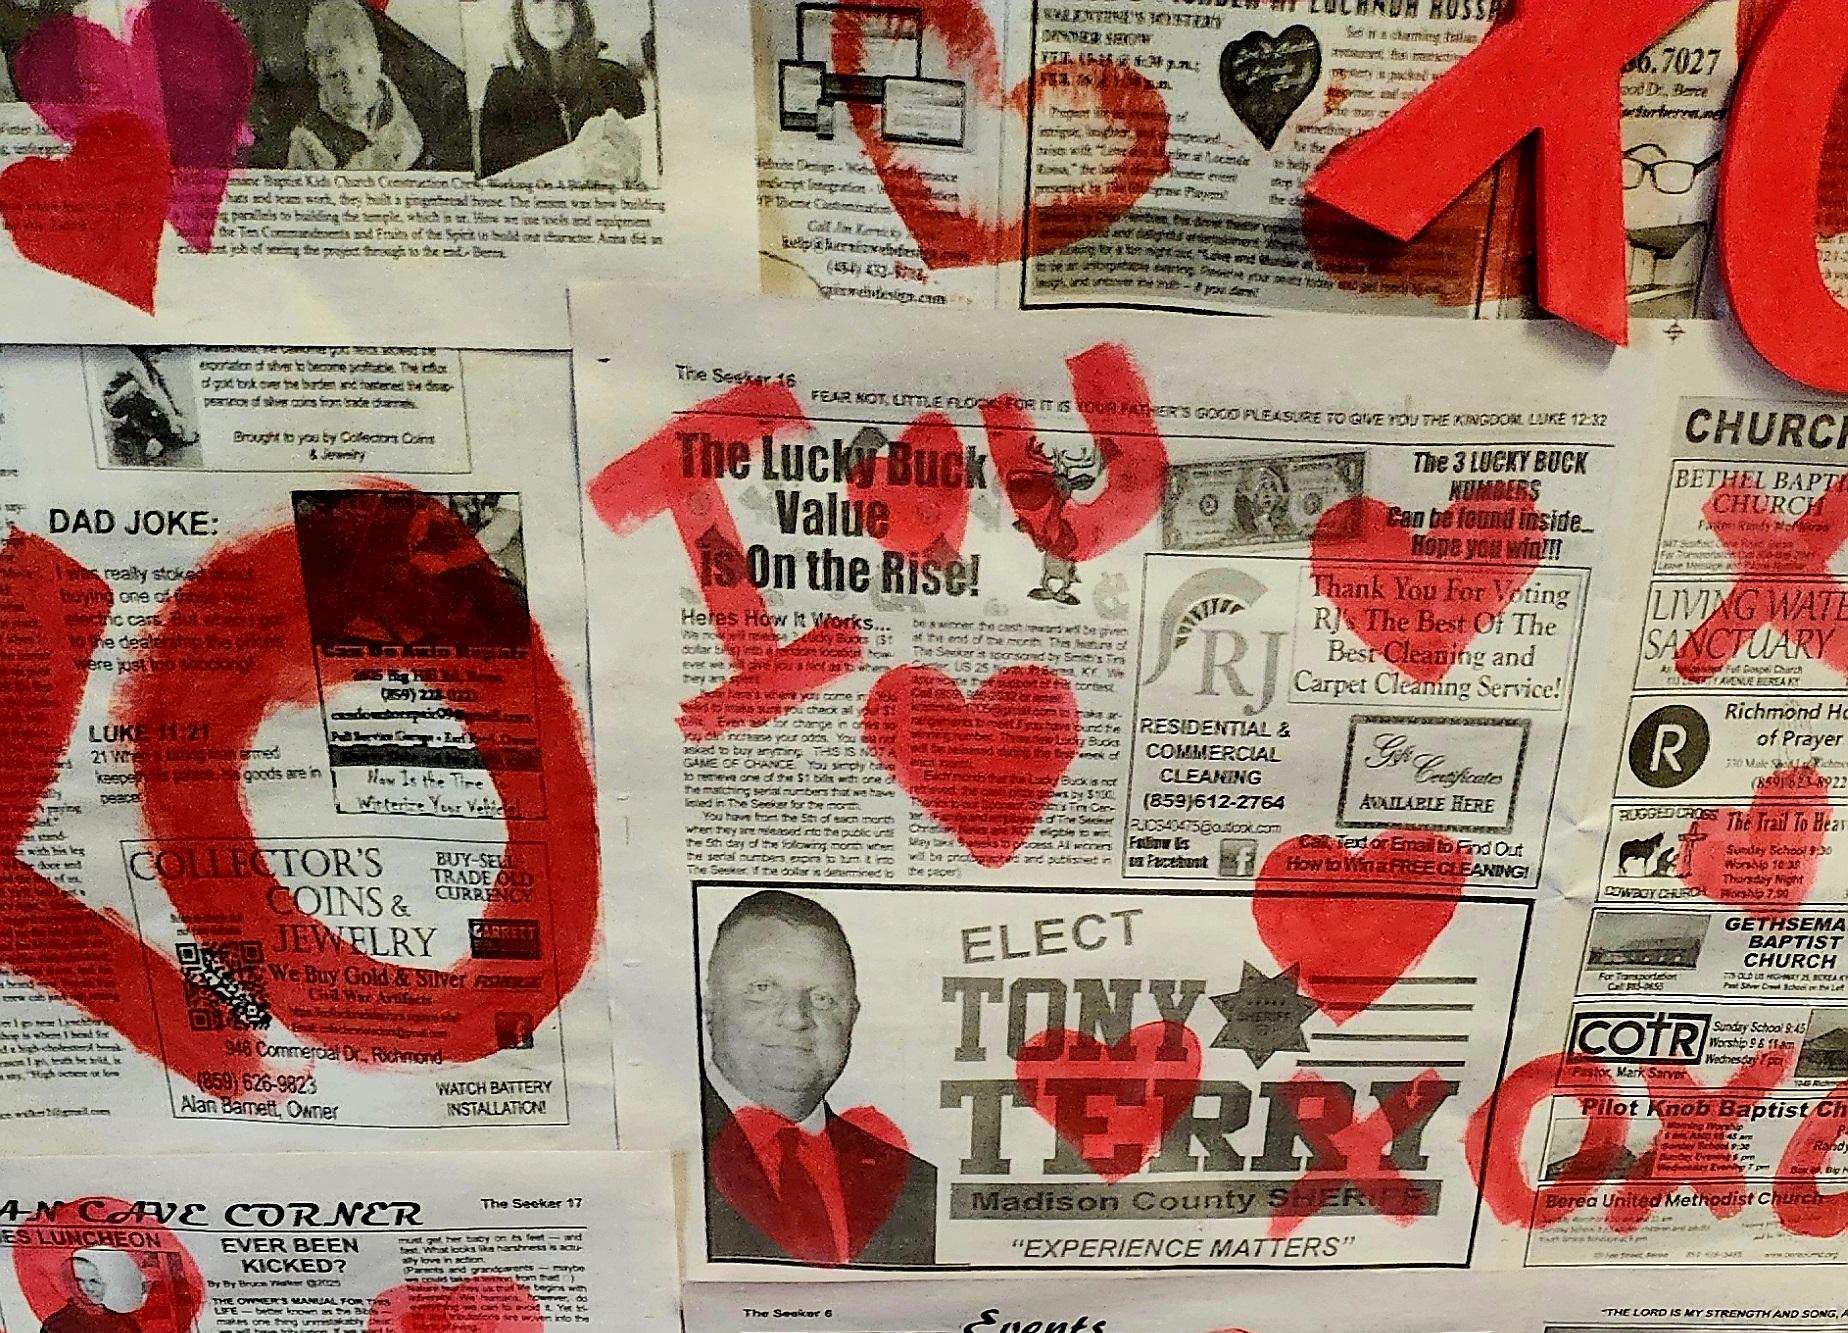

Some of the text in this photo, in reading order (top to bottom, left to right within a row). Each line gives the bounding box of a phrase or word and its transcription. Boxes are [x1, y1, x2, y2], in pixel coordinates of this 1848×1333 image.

[675, 364, 708, 382] The
[777, 372, 797, 388] 16
[1243, 408, 1321, 424] PLEASURE
[1422, 413, 1450, 427] THE
[1529, 412, 1567, 426] LUKE
[676, 431, 988, 490] The Lucky Buck
[1414, 450, 1589, 476] The 3 LUCKY BUCK
[1674, 468, 1765, 490] BETHEL
[774, 489, 891, 540] Value
[1712, 493, 1826, 517] CHURCH
[49, 508, 218, 536] DAD JOKE:
[1386, 505, 1513, 531] Can be found
[1410, 535, 1503, 561] Hope you
[700, 543, 982, 598] is On the Rise!
[1311, 573, 1571, 610] Thank You For Voting
[1652, 587, 1759, 621] LIVING
[681, 607, 739, 627] Heres
[744, 607, 787, 628] How
[1364, 606, 1410, 634] The
[1416, 608, 1467, 635] Best
[1473, 611, 1506, 636] Of
[1512, 612, 1558, 637] The
[1327, 638, 1536, 670] Best Cleaning and
[1644, 628, 1836, 660] SANCTUARY
[1194, 628, 1290, 717] RJ
[1293, 668, 1563, 702] Carpet Cleaning Service!
[1724, 702, 1821, 721] Richmond
[87, 723, 148, 743] LUKE
[1139, 717, 1291, 738] RESIDENTIAL &
[1146, 743, 1282, 762] COMMERCIAL
[1649, 723, 1688, 773] R
[1756, 729, 1844, 752] of Prayer
[1159, 768, 1262, 785] CLEANING
[1143, 793, 1286, 812] (859)612-2764
[1358, 793, 1496, 814] AVAILABLE HERE
[1727, 811, 1751, 833] The
[1756, 811, 1788, 833] Trail
[1793, 812, 1809, 833] To
[1456, 839, 1524, 858] Find Out
[129, 847, 384, 882] COLLECTOR'S
[1286, 855, 1530, 880] How FREE CLEANING!
[429, 868, 536, 888] TRADE OLD
[266, 885, 412, 918] COINS &
[435, 886, 534, 904] CURRENCY
[270, 925, 438, 958] JEWELRY
[961, 908, 1144, 965] ELECT
[1748, 934, 1844, 950] BAPTIST
[1743, 952, 1838, 969] CHURCH
[270, 961, 467, 989] We Buy Gold Silver
[941, 976, 1208, 1063] TONY
[1712, 1021, 1749, 1035] Sunday
[255, 1040, 445, 1066] Commercial Richmond
[242, 1072, 319, 1095] 626-9823
[435, 1079, 553, 1096] WATCH BATTERY
[180, 1094, 340, 1121] Alan Owner
[1581, 1097, 1809, 1122] Pilot Knob Baptist
[939, 1079, 1461, 1176] TERRY
[480, 1197, 583, 1211] The Seeker 17
[971, 1185, 1429, 1215] Madison County SHERIFF
[1544, 1191, 1824, 1210] Berea United Methodist Church
[78, 1200, 425, 1228] CAVE CORNER
[36, 1230, 162, 1248] LUNCHEON
[220, 1237, 360, 1254] EVER BEEN
[240, 1257, 348, 1275] KICKED?
[742, 1307, 821, 1319] The Seeker
[1632, 1308, 1772, 1319] LORD STRENGTH
